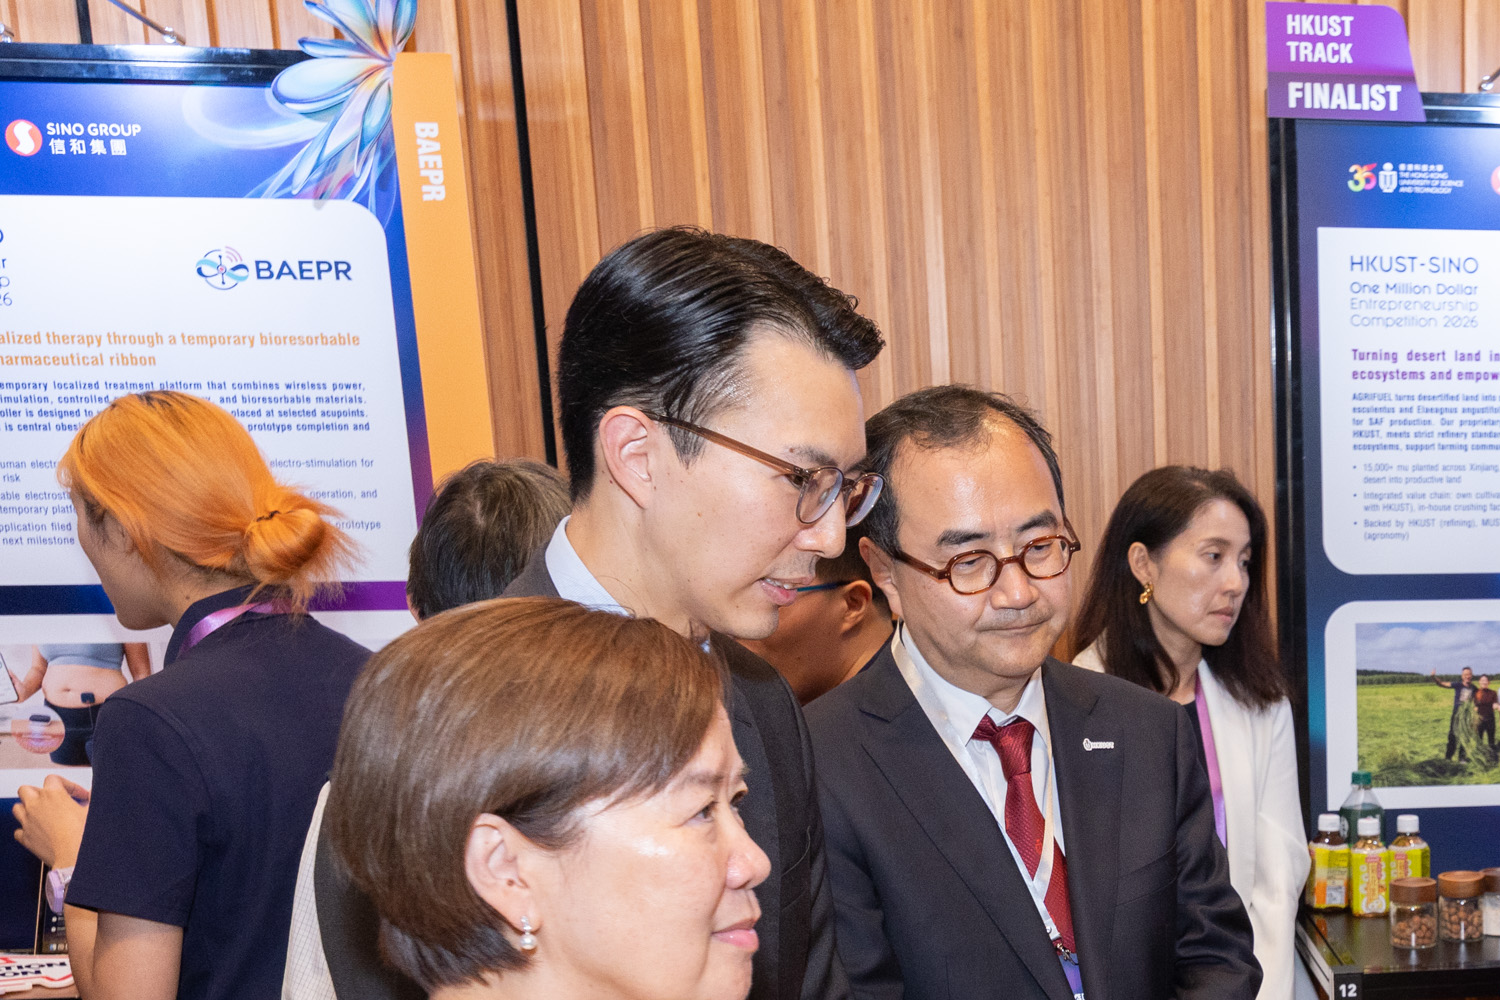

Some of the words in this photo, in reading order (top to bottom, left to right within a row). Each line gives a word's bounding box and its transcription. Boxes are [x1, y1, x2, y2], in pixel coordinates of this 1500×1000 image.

[1286, 14, 1354, 37] HKUST
[1286, 41, 1353, 64] TRACK
[1288, 82, 1402, 111] FINALIST
[46, 122, 85, 136] SINO
[87, 122, 142, 137] GROUP
[414, 122, 446, 202] BAEPR
[254, 260, 352, 281] BAEPR
[1350, 256, 1479, 274] HKUST-SINO
[1350, 281, 1380, 294] One
[1385, 283, 1432, 294] Million
[1436, 283, 1478, 295] Dollar
[1350, 298, 1479, 313] Entrepreneurship
[1349, 314, 1438, 328] Competition
[1443, 315, 1479, 328] 2026
[45, 331, 102, 348] therapy
[106, 331, 164, 348] through
[167, 334, 177, 346] a
[180, 332, 255, 349] temporary
[259, 332, 361, 347] bioresorbable
[109, 352, 157, 367] ribbon
[1351, 350, 1398, 363] Turning
[1407, 351, 1446, 362] desert
[1455, 351, 1481, 362] land
[1352, 369, 1425, 382] ecosystems
[1430, 369, 1452, 380] and
[53, 381, 99, 390] localized
[104, 381, 154, 390] treatment
[207, 381, 226, 390] that
[232, 381, 279, 390] combines
[285, 381, 327, 390] wireless
[332, 383, 365, 391] power,
[57, 394, 109, 404] controlled
[219, 395, 237, 404] and
[241, 394, 311, 404] bioresorbable
[316, 395, 366, 404] materials.
[25, 409, 34, 417] is
[38, 408, 80, 419] designed
[84, 408, 93, 417] to
[266, 409, 274, 417] at
[278, 408, 317, 417] selected
[321, 409, 367, 419] acupoints.
[5, 423, 13, 431] is
[17, 422, 51, 431] central
[248, 422, 292, 433] prototype
[296, 422, 349, 432] completion
[353, 422, 370, 431] and
[3, 473, 21, 483] risk
[1339, 983, 1357, 998] 12
